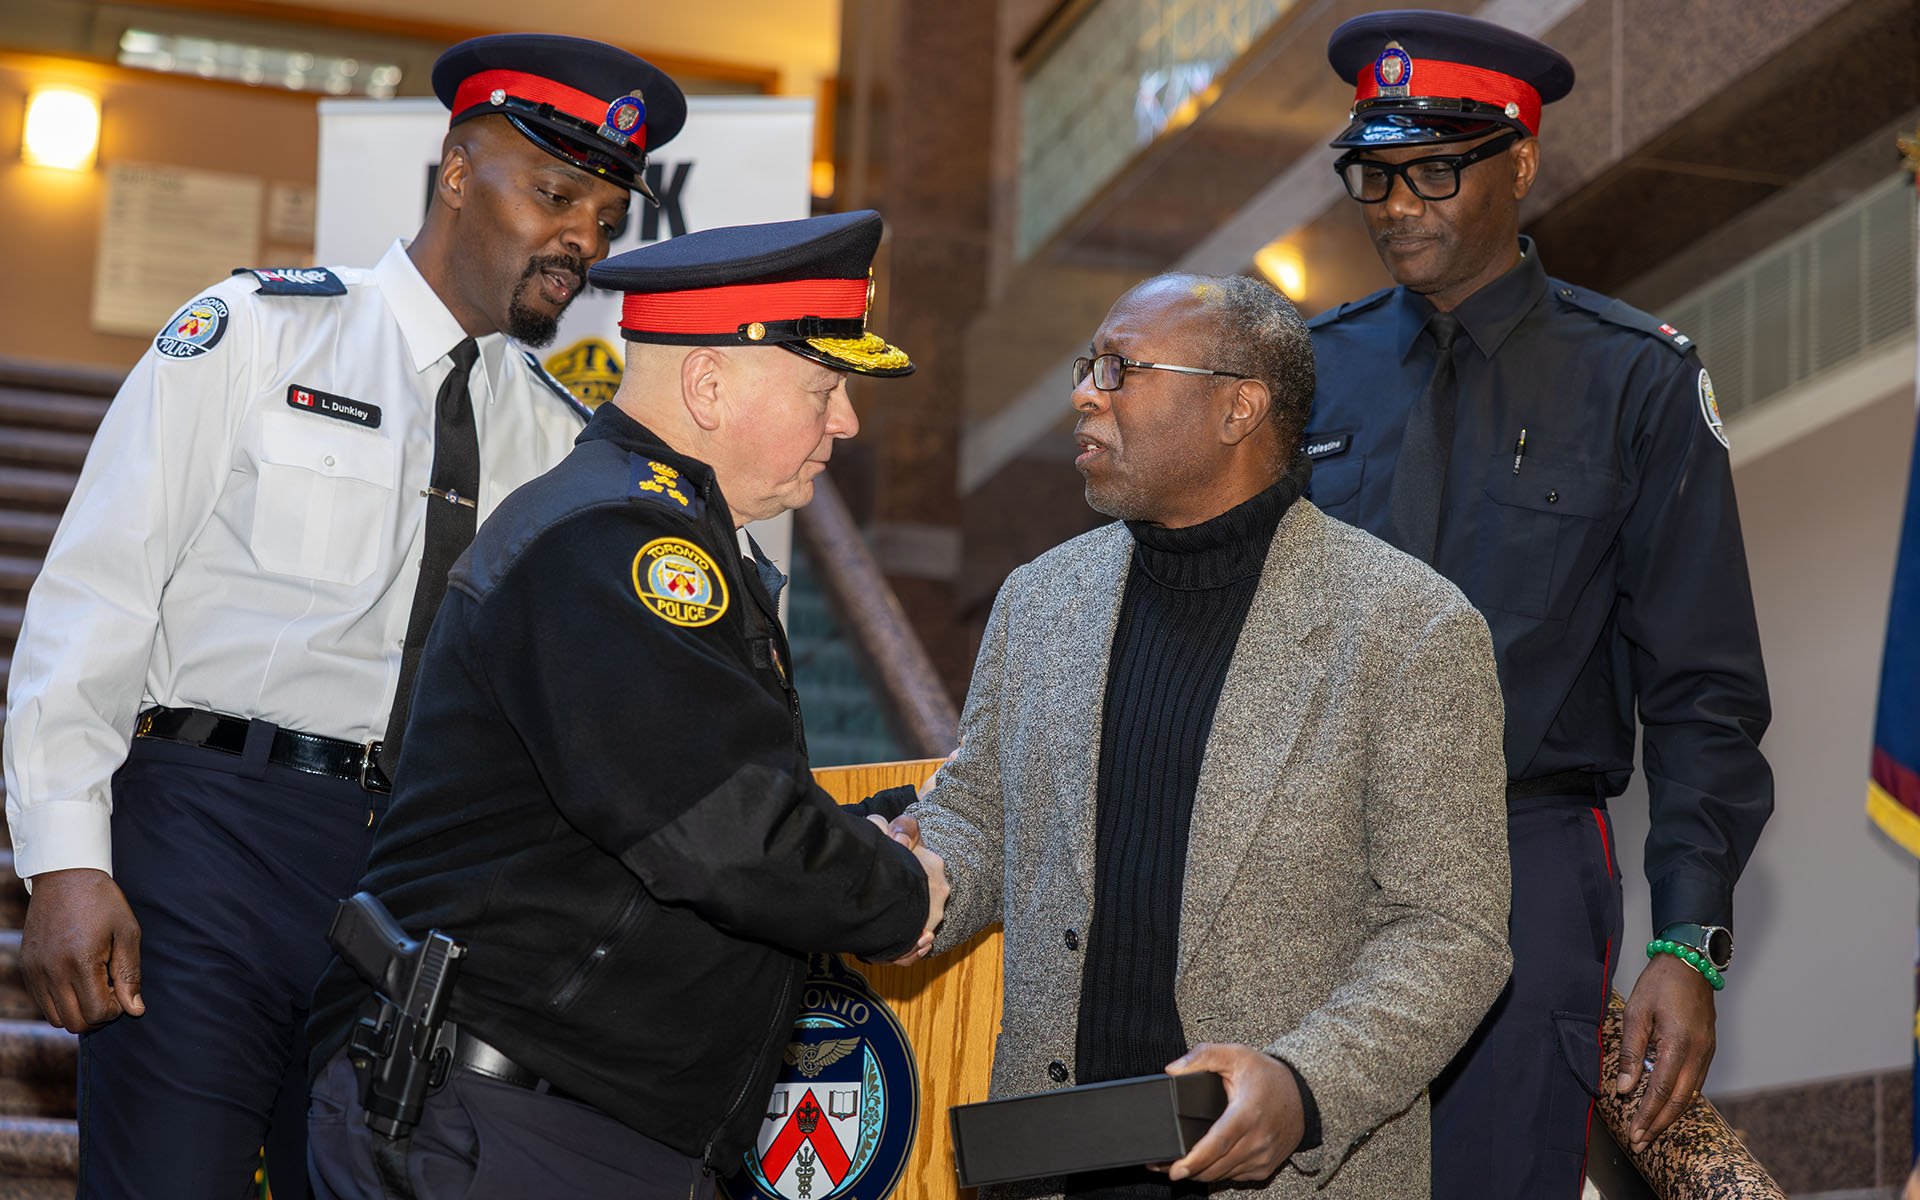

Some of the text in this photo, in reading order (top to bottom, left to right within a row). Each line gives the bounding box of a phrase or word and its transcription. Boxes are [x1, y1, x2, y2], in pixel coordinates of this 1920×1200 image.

[189, 298, 228, 318] RONTO
[159, 339, 197, 356] POLICE
[321, 399, 369, 421] L. Dunkley
[1307, 441, 1341, 455] Celestine
[647, 544, 710, 571] TORONTO
[657, 600, 707, 621] POLICE
[800, 988, 870, 1025] ONTO
